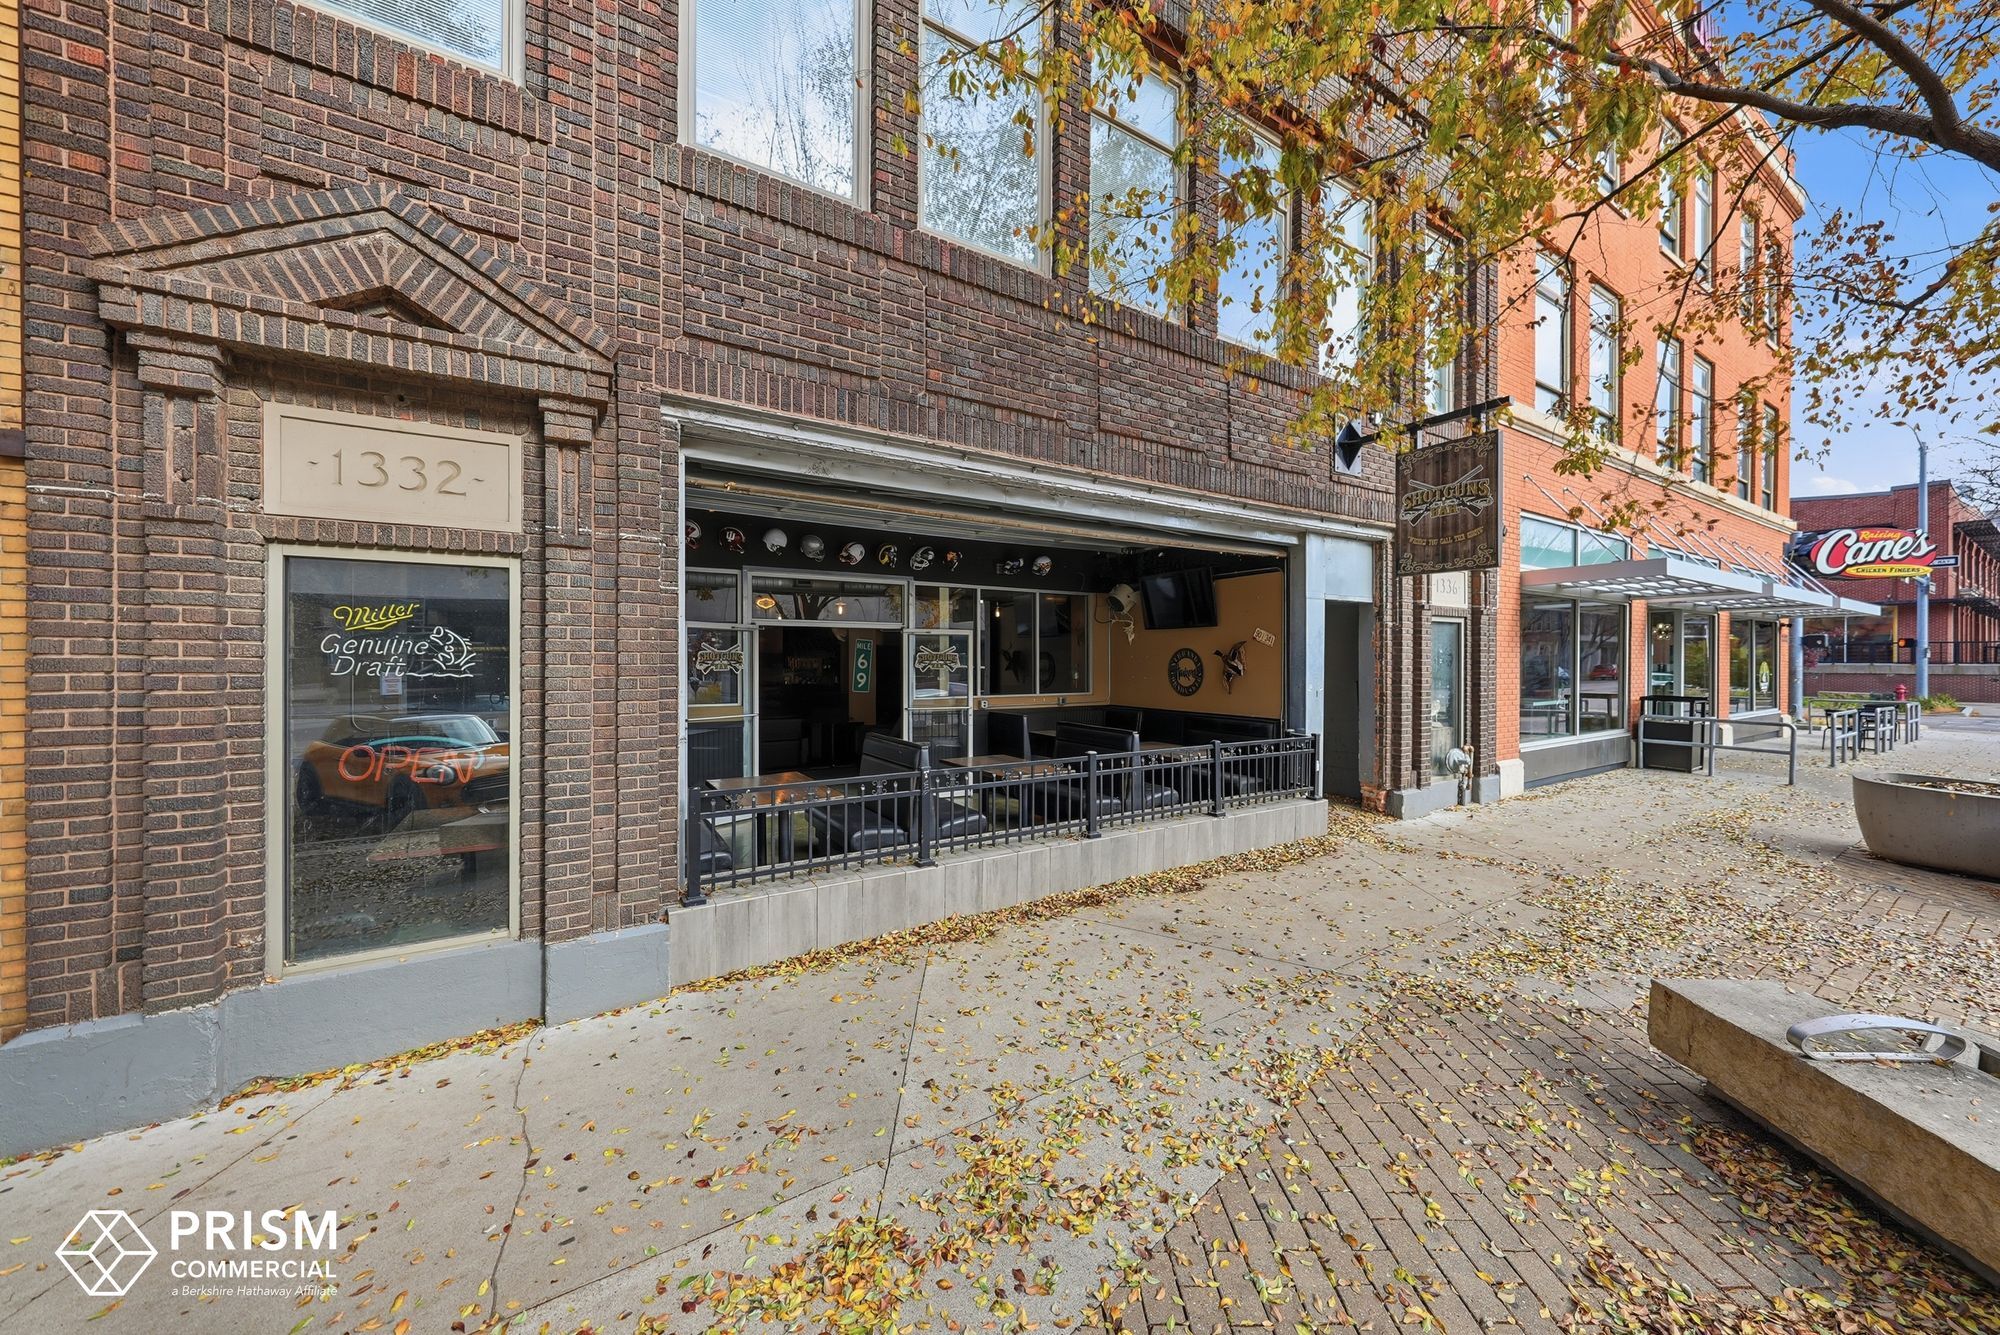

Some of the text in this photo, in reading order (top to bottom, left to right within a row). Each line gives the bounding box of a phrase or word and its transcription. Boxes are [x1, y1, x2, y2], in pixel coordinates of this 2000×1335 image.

[1402, 480, 1490, 509] SHOTGUNS
[1860, 531, 1902, 540] Raising
[1816, 529, 1937, 574] Cane's
[333, 603, 420, 628] Miller
[320, 633, 429, 655] Genuine
[856, 642, 871, 650] MILE
[331, 655, 407, 677] Draft
[337, 744, 476, 784] OPEN
